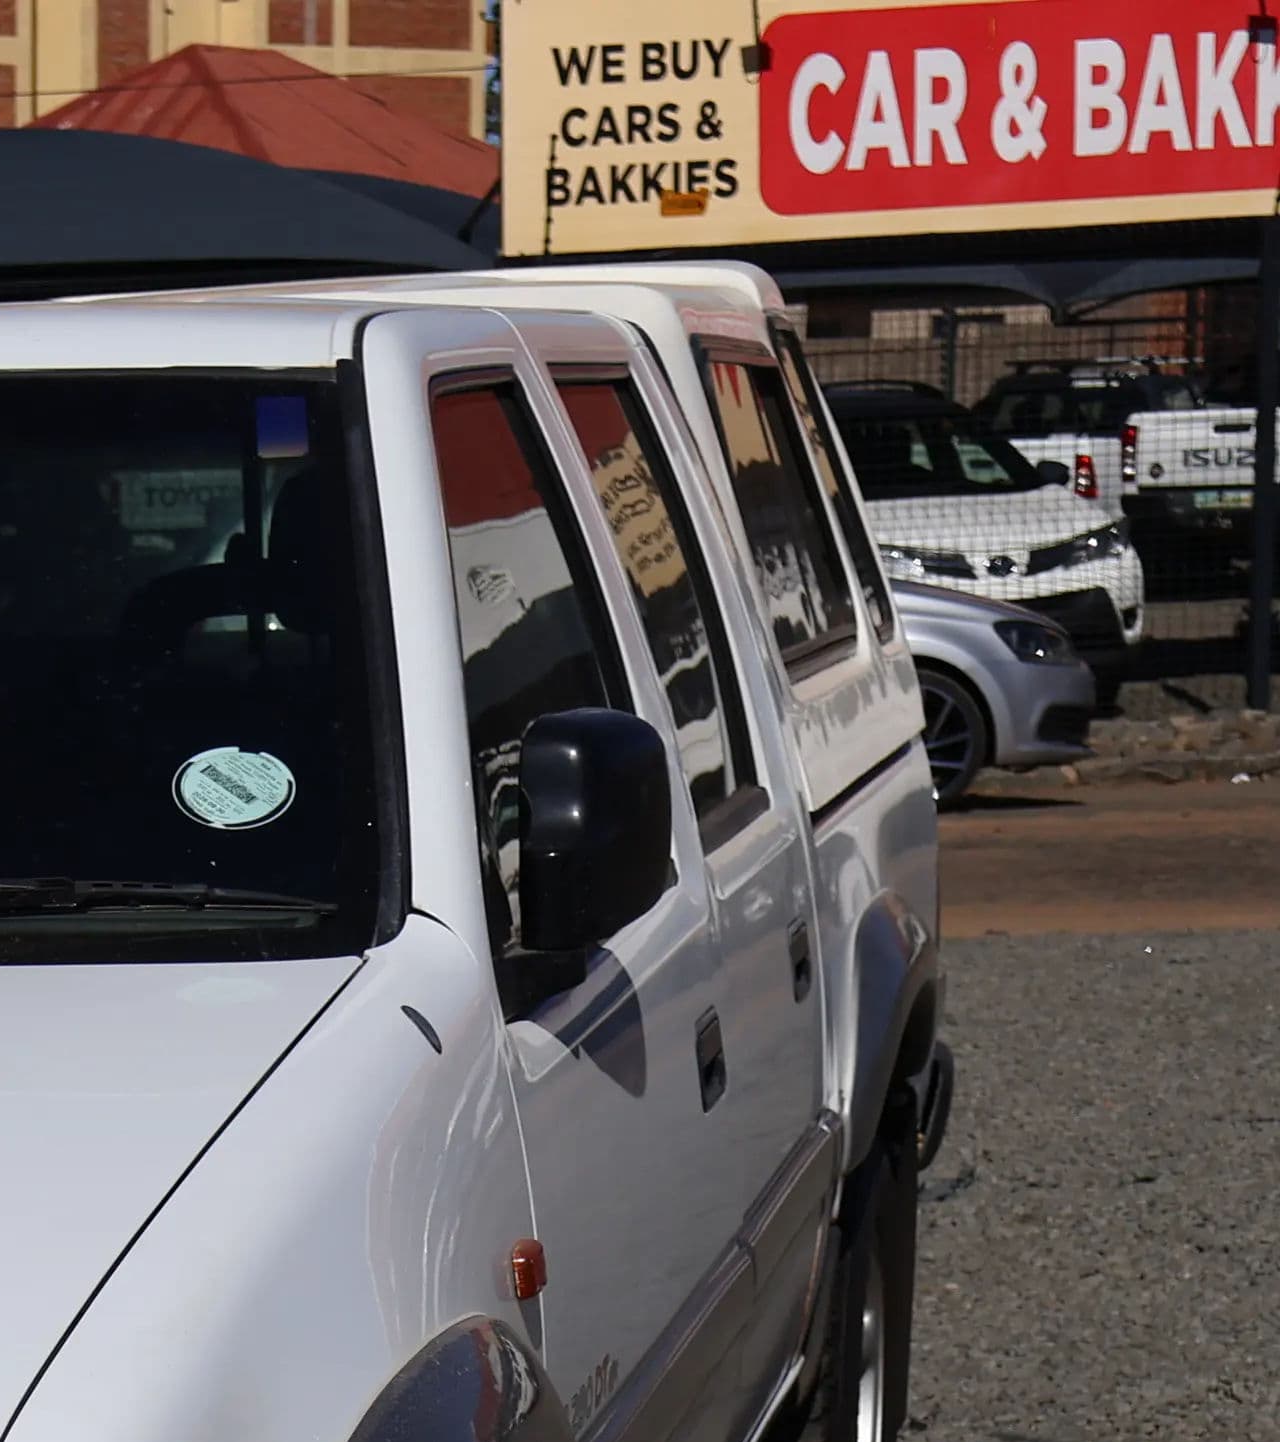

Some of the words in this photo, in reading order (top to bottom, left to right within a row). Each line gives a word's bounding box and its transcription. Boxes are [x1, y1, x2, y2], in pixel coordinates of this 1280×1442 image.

[550, 44, 625, 87] WE
[641, 37, 732, 82] BUY
[560, 102, 682, 147] CARS
[695, 100, 723, 140] &
[787, 47, 969, 175] CAR
[990, 40, 1048, 164] &
[545, 158, 739, 207] BAKKIES
[1183, 448, 1257, 468] ISUZ
